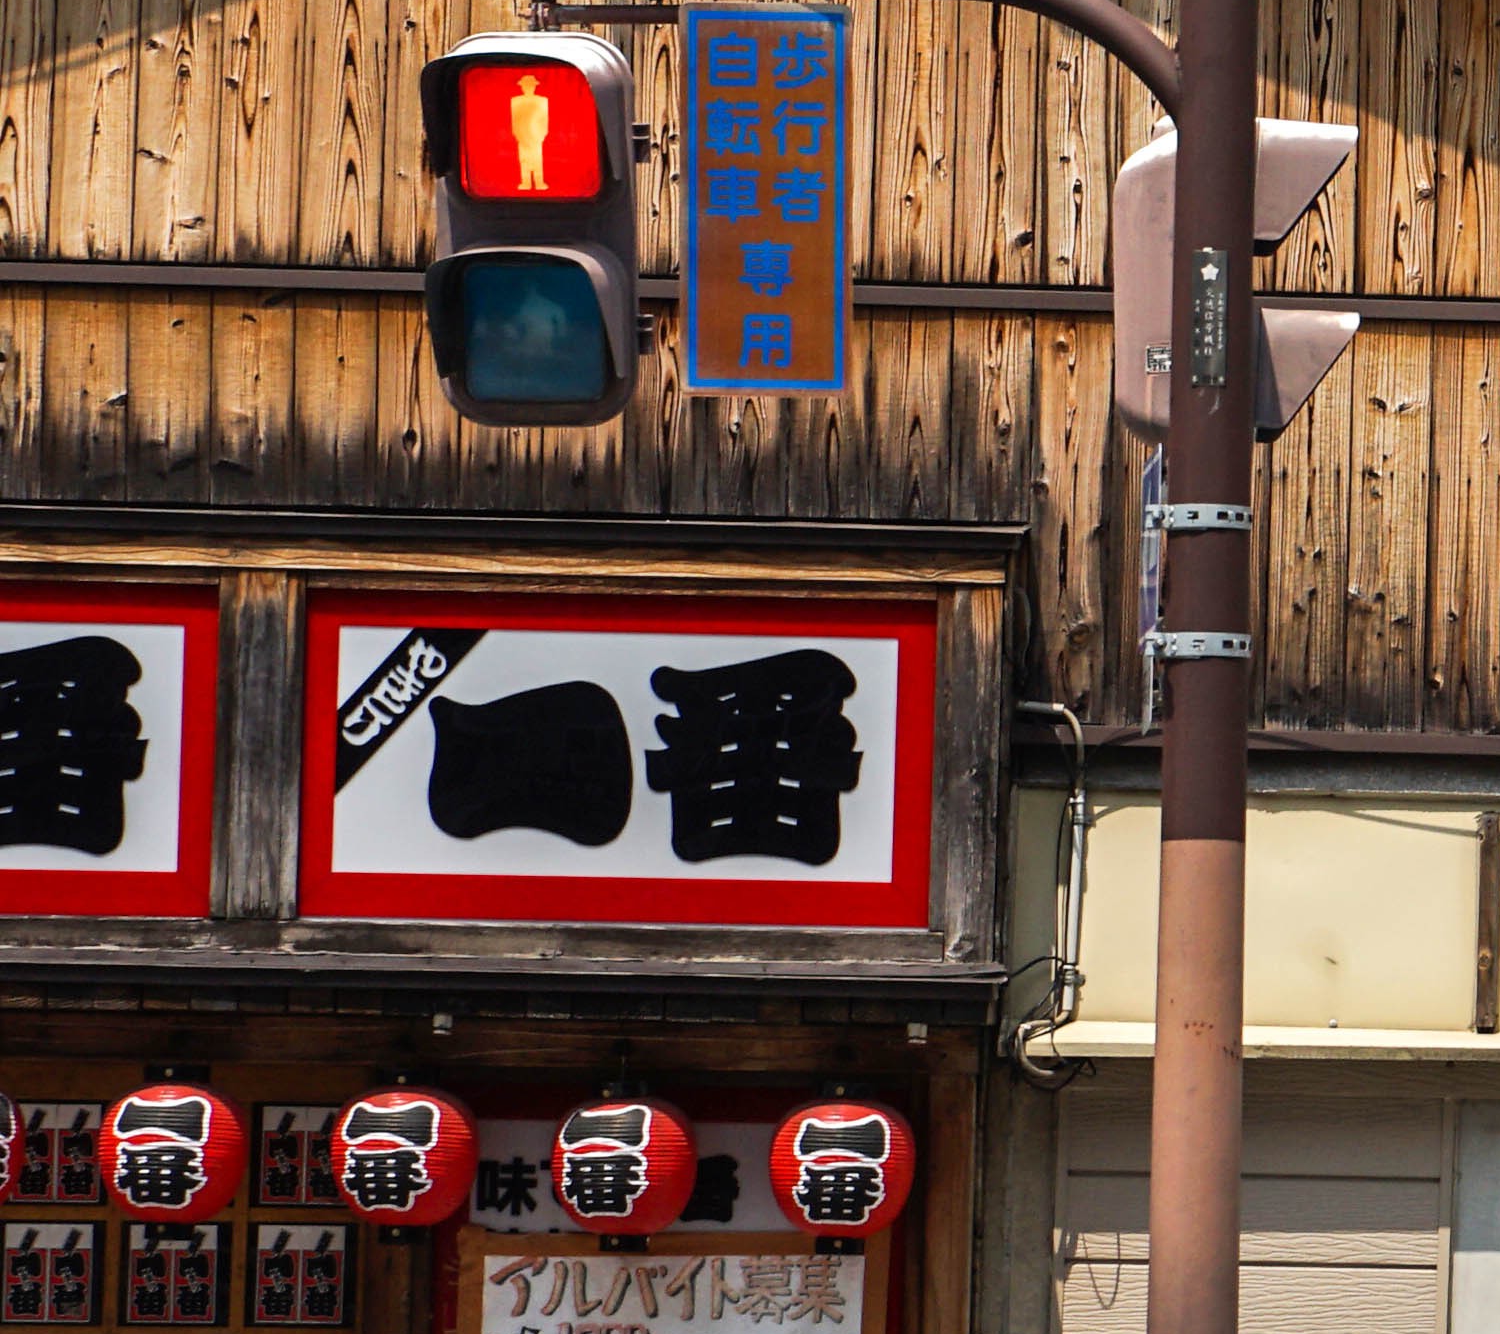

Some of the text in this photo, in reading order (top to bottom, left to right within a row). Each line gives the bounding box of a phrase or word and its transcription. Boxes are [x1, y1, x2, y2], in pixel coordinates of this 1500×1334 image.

[704, 32, 762, 224] 自転車
[772, 32, 829, 224] 歩行者
[738, 239, 794, 368] 専用
[427, 647, 864, 865] 一番
[113, 1096, 208, 1209] 一番
[340, 1098, 438, 1211] 一番
[560, 1104, 653, 1218] 一番
[791, 1110, 891, 1227] 一番
[489, 1255, 846, 1325] アルバイト募集
